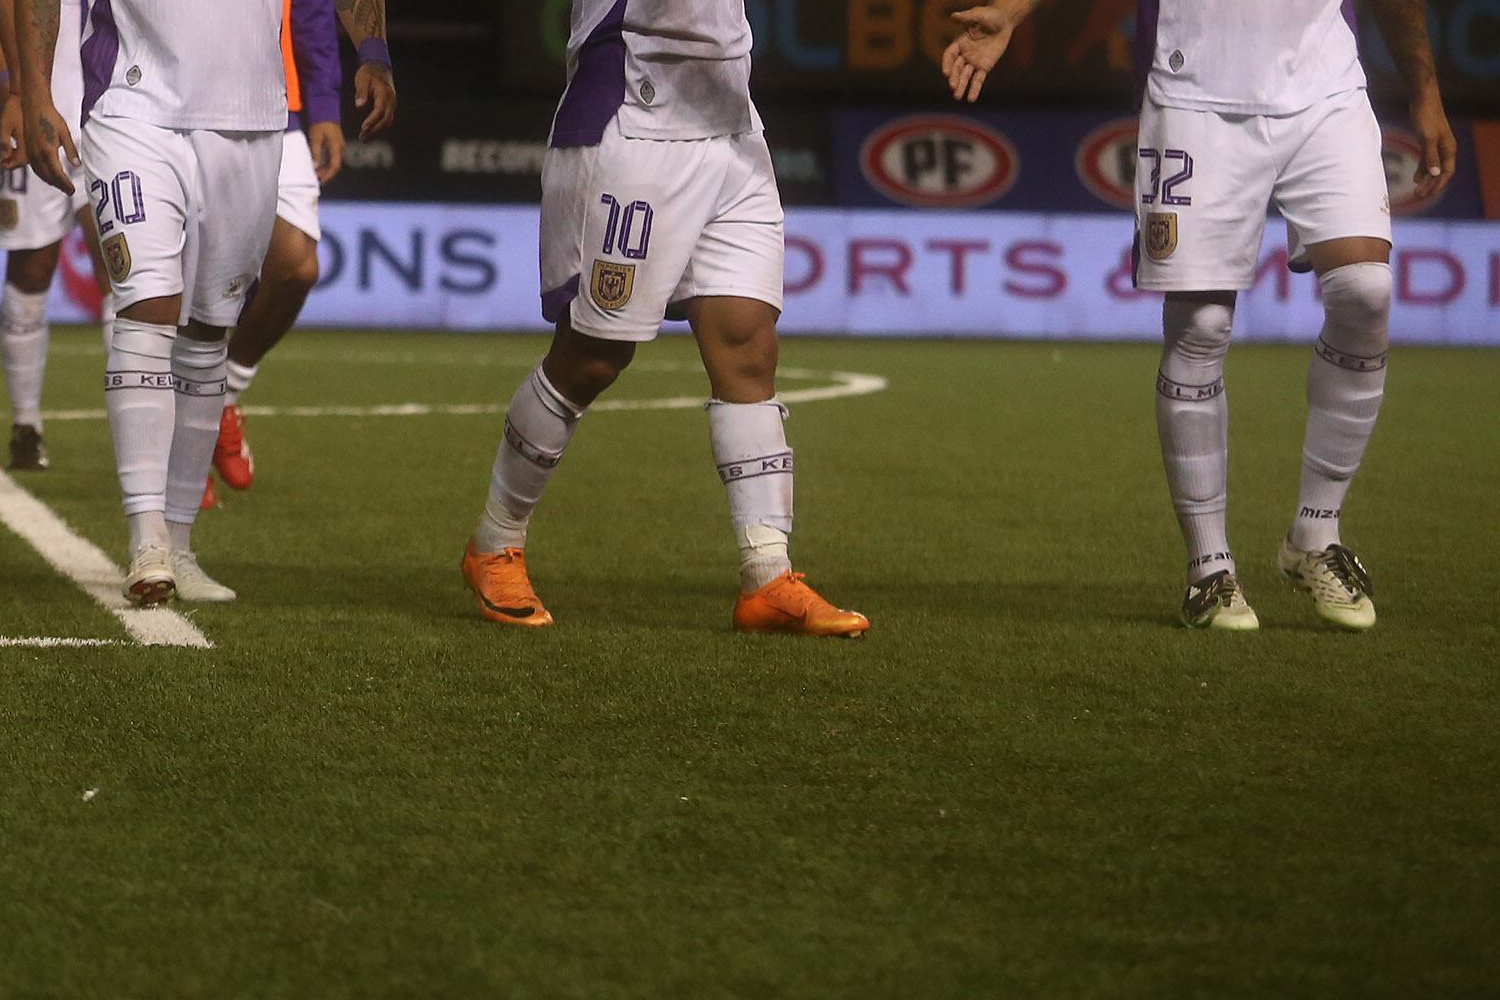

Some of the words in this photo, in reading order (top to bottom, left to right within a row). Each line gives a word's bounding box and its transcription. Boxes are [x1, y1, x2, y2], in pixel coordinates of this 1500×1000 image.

[902, 138, 975, 188] PF
[1139, 148, 1193, 206] 32
[91, 170, 147, 236] 20
[601, 193, 654, 260] 10
